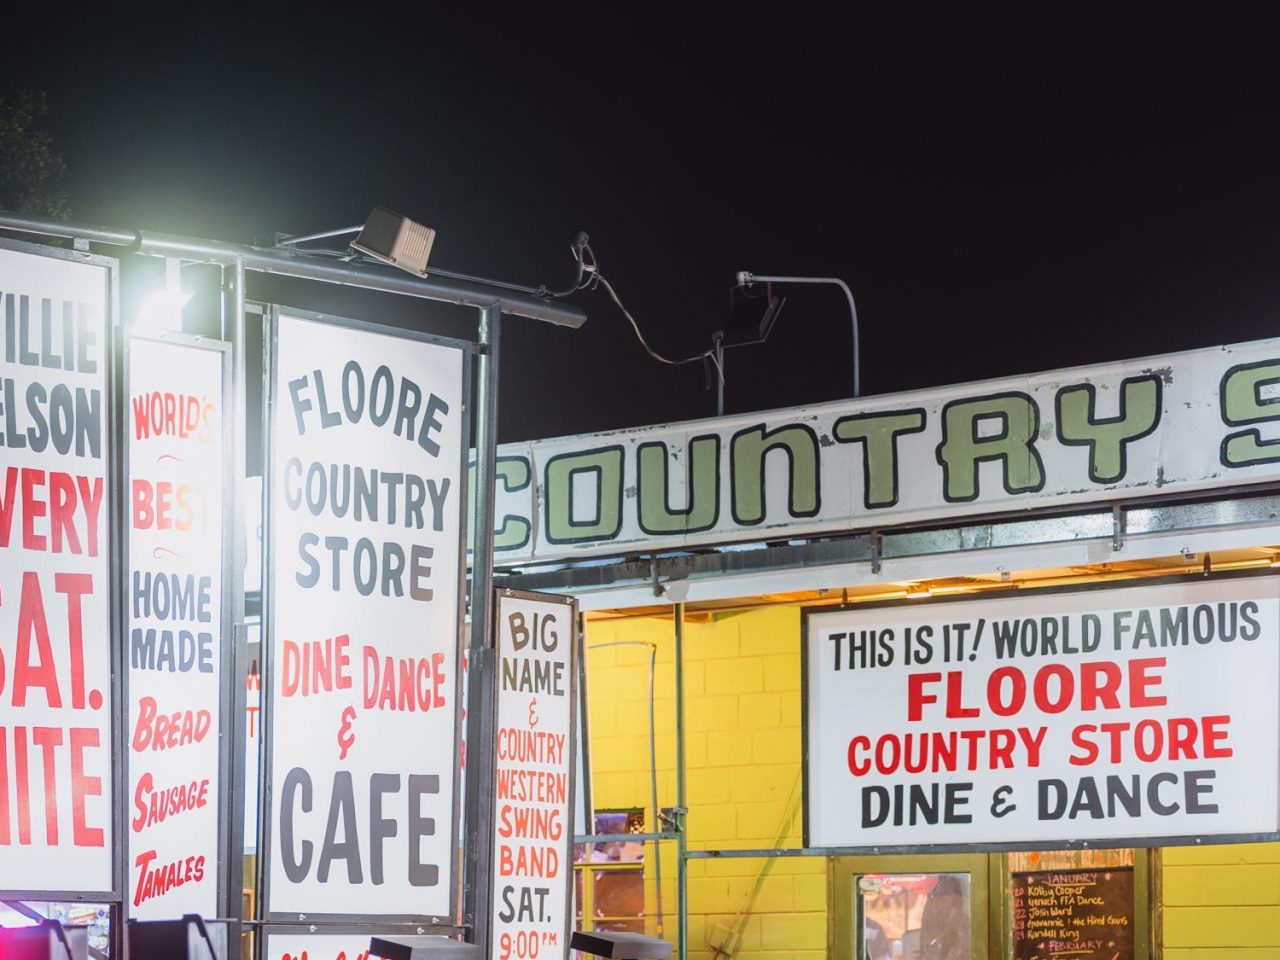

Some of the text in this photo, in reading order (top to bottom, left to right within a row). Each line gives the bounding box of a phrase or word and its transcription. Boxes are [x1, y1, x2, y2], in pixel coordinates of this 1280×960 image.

[288, 360, 449, 458] FLOORE
[467, 373, 1163, 552] COUNTRY
[284, 457, 451, 532] COUNTRY
[295, 532, 434, 602] STORE
[132, 570, 212, 624] HOME
[131, 628, 214, 673] MADE
[508, 611, 558, 653] BIG
[828, 601, 1261, 671] THIS IS IT! WORLD FAMOUS
[281, 634, 353, 698] DINE
[363, 645, 446, 712] DANCE
[502, 657, 565, 697] NAME
[907, 657, 1168, 722] FLOORE
[131, 696, 212, 753] BREAD
[337, 704, 358, 760] &
[497, 727, 566, 766] COUNTRY
[847, 714, 1234, 777] COUNTRY STORE
[132, 772, 209, 833] SAUSAGE
[497, 769, 566, 805] WESTERN
[861, 769, 1219, 829] DINE & DANCE
[280, 767, 440, 887] CAFE
[498, 805, 562, 842] SWING
[133, 850, 205, 907] TAMALES
[499, 844, 558, 879] BAND
[1048, 872, 1097, 884] JANUARY
[499, 886, 552, 924] SAT.
[500, 931, 540, 960] 9:00
[1049, 940, 1103, 953] FEBRUARY
[1059, 928, 1080, 941] King
